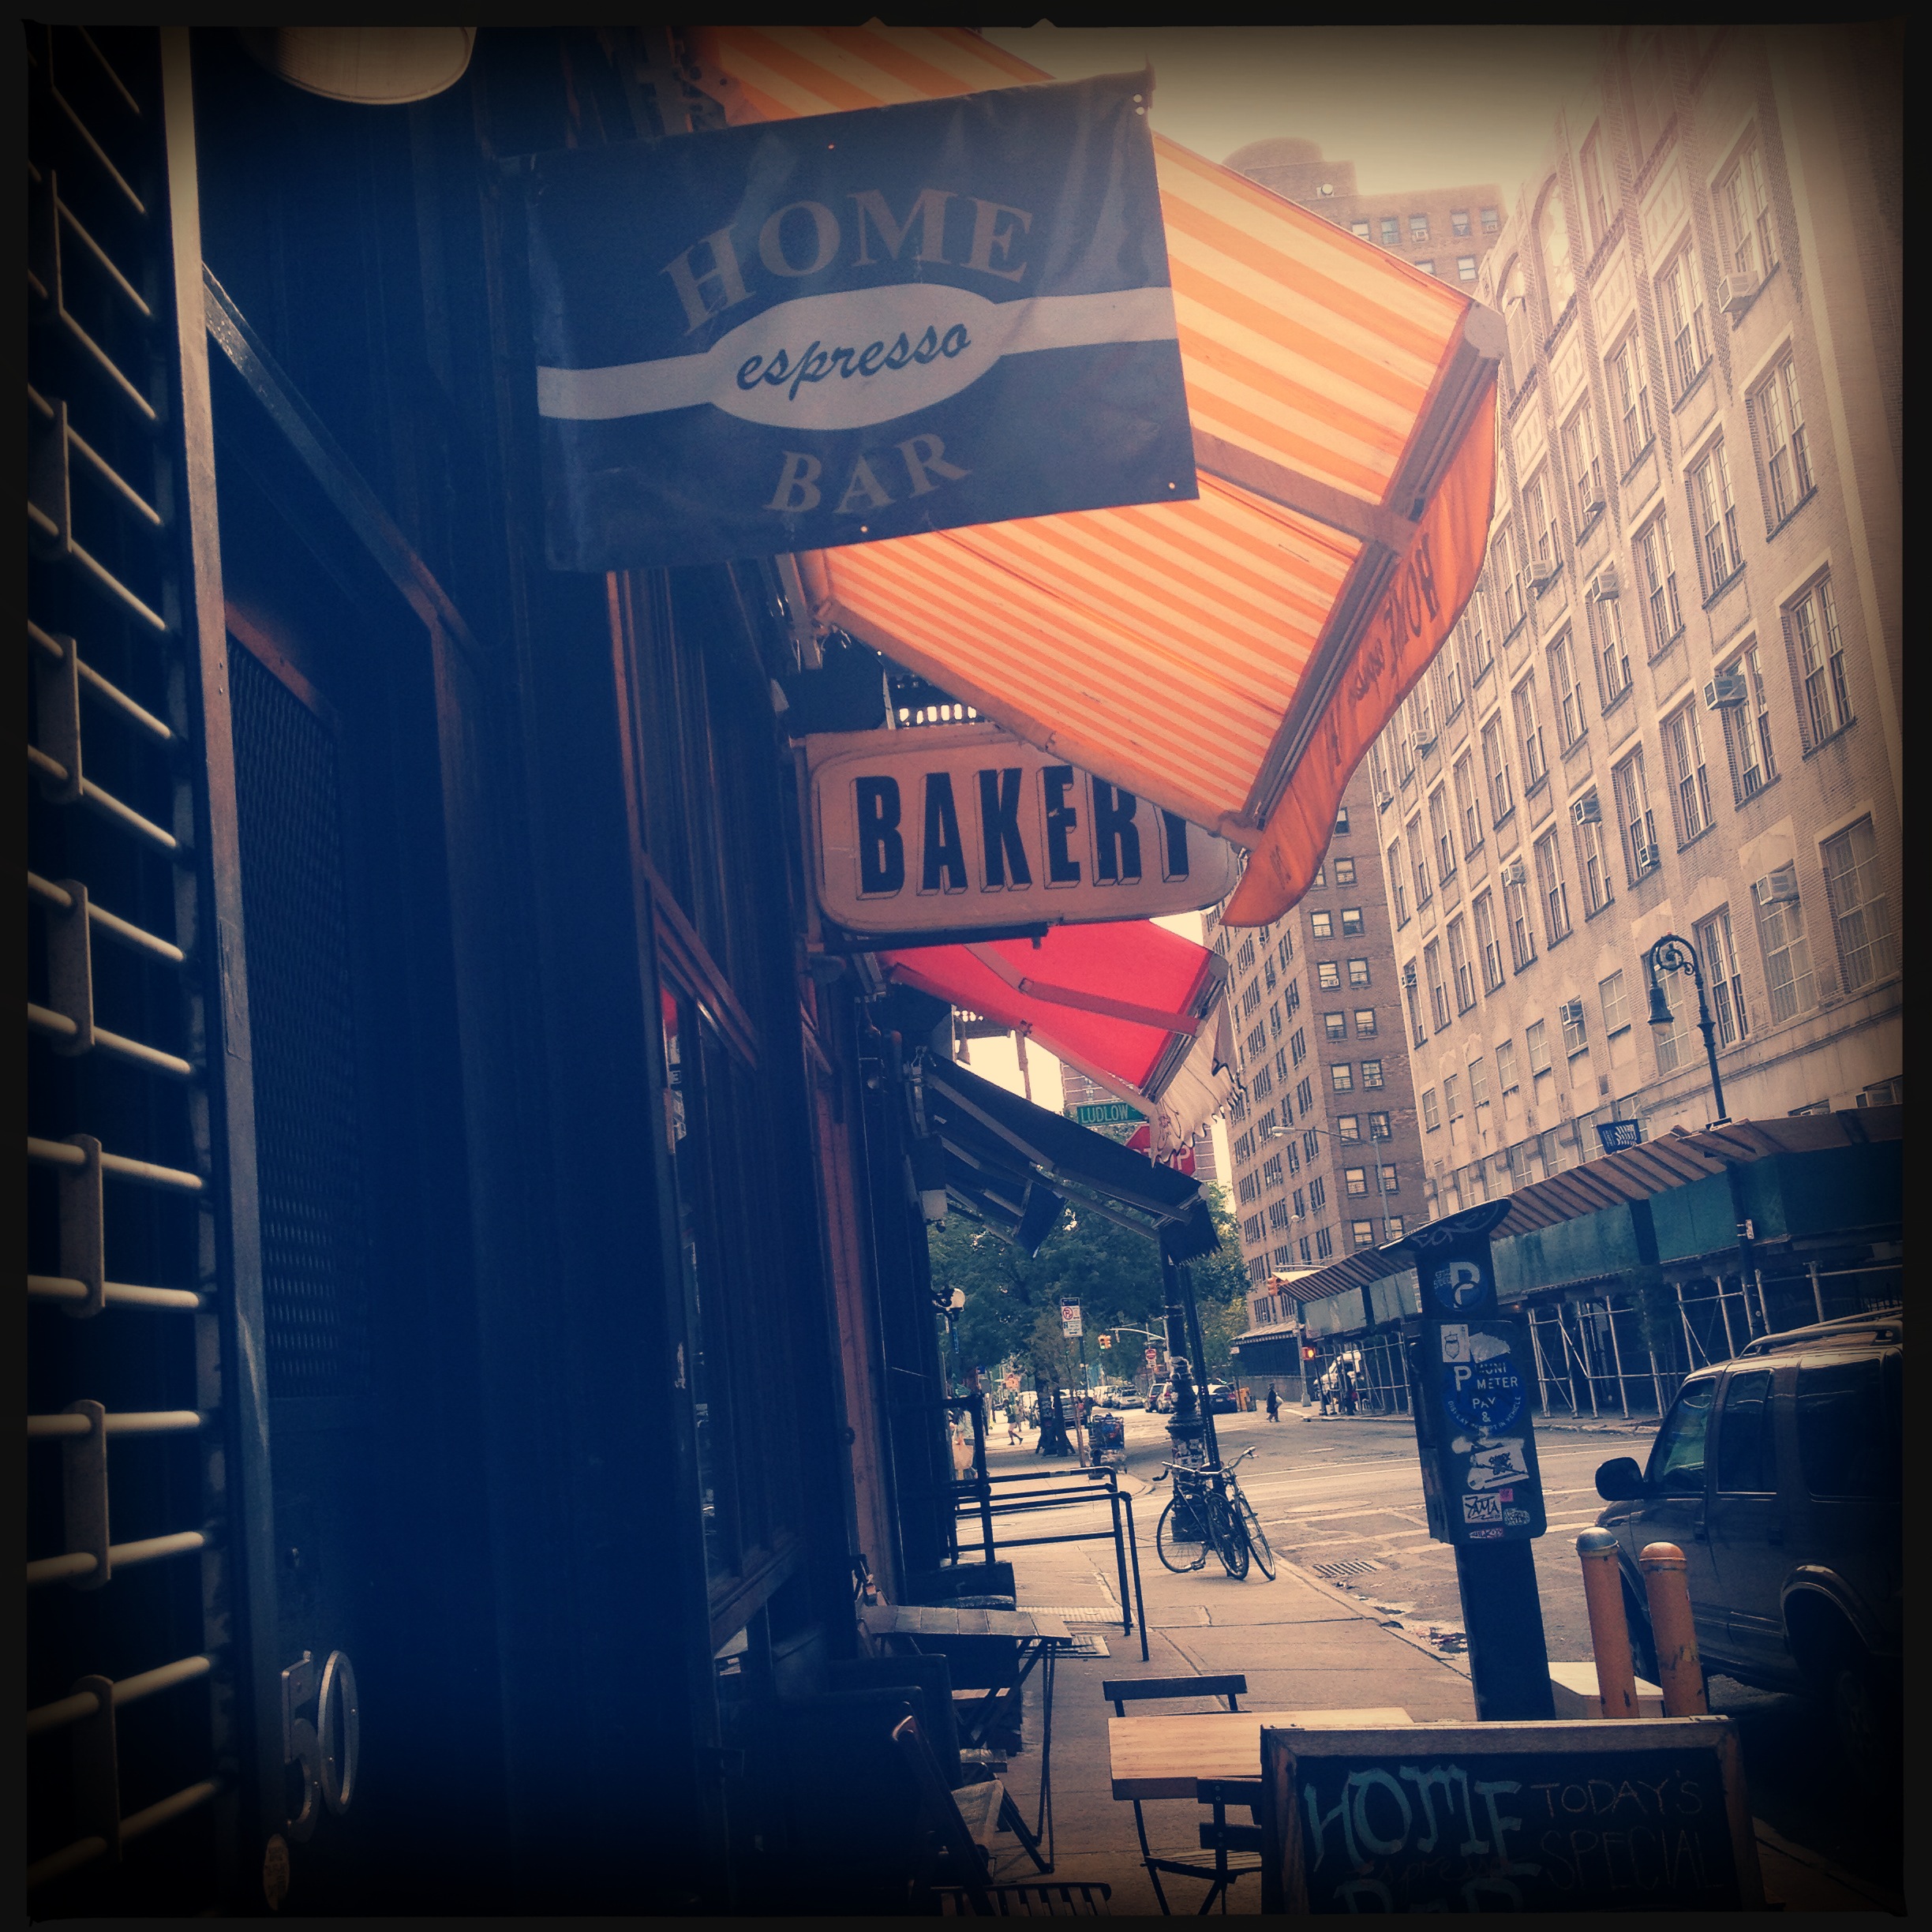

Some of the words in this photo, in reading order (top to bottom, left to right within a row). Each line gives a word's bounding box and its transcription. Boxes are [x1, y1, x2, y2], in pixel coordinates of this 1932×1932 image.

[660, 187, 1034, 337] HOME
[736, 322, 972, 401] espresso
[764, 433, 973, 514] BAR
[1080, 1105, 1129, 1124] LUDLOW
[1454, 1365, 1472, 1391] P
[1477, 1376, 1518, 1389] METER
[280, 1649, 359, 1843] 50
[1304, 1764, 1541, 1877] HOME
[1530, 1769, 1703, 1818] TODAY'S
[1540, 1825, 1724, 1891] SPECIAL
